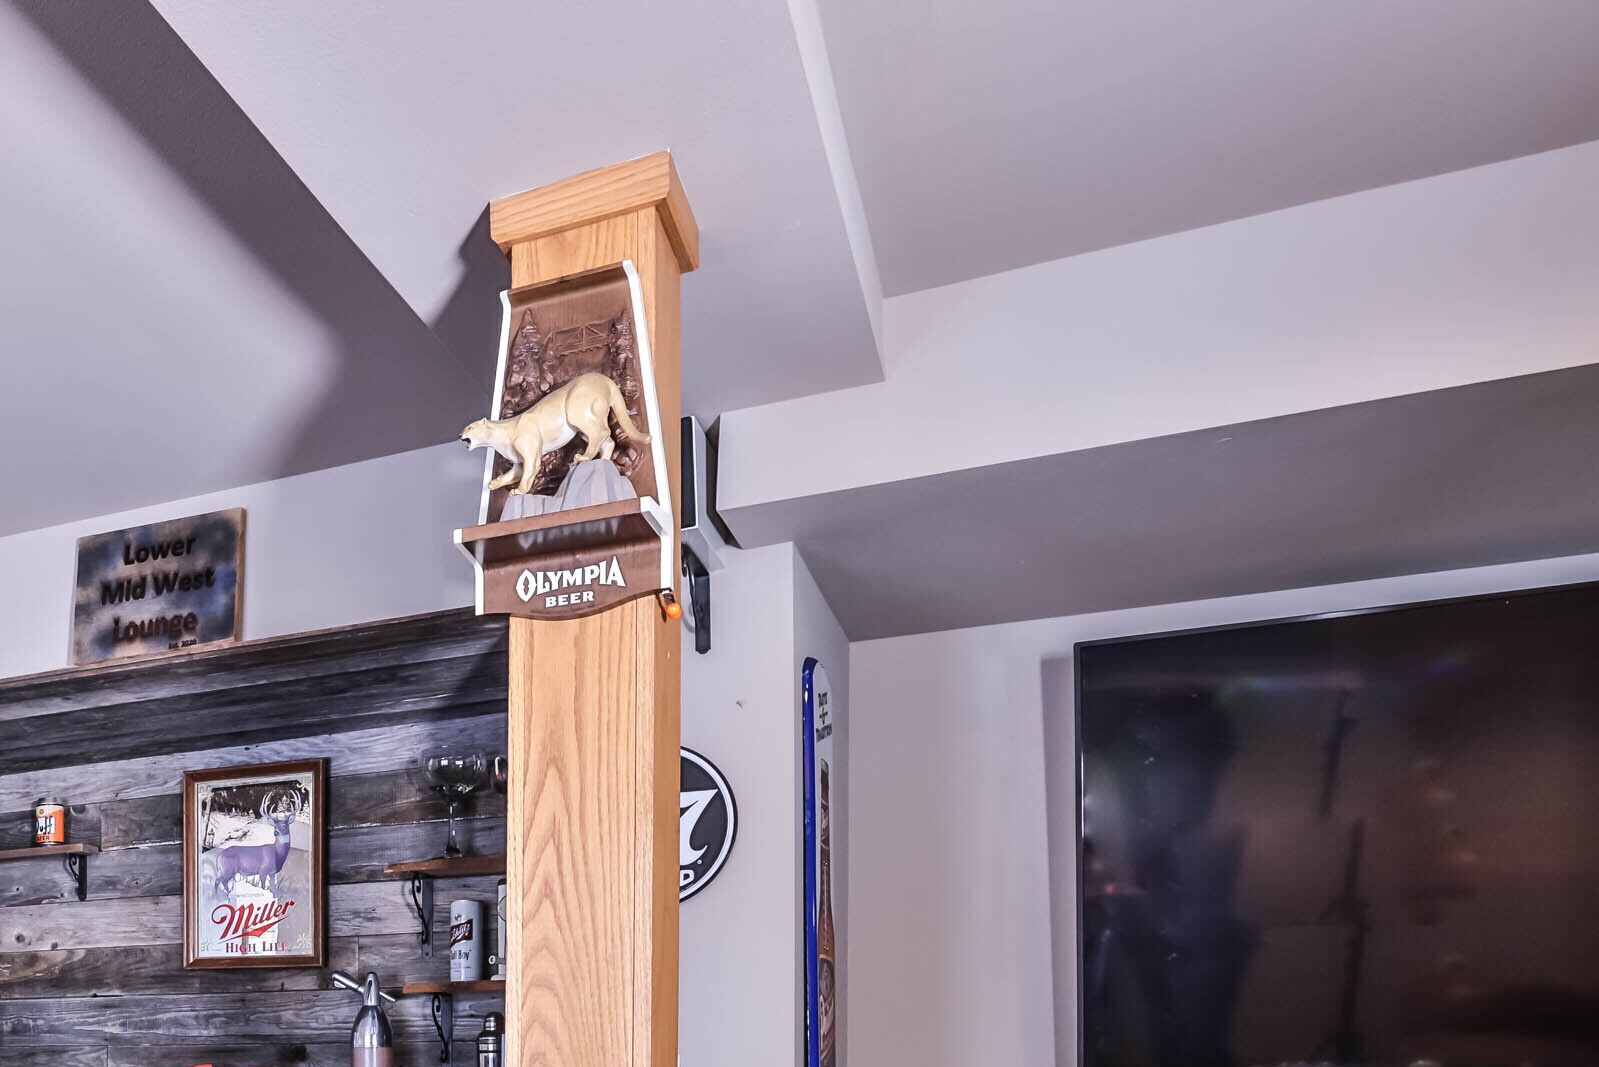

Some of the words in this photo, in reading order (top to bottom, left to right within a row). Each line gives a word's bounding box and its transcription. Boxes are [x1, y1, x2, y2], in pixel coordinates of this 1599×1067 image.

[124, 538, 197, 565] Lower
[100, 575, 147, 606] Mid
[152, 567, 215, 596] West
[515, 555, 626, 602] OLYMPIA
[545, 590, 595, 608] BEER
[112, 612, 198, 644] Lounge
[211, 900, 296, 940] Miller
[225, 942, 256, 954] HIGH
